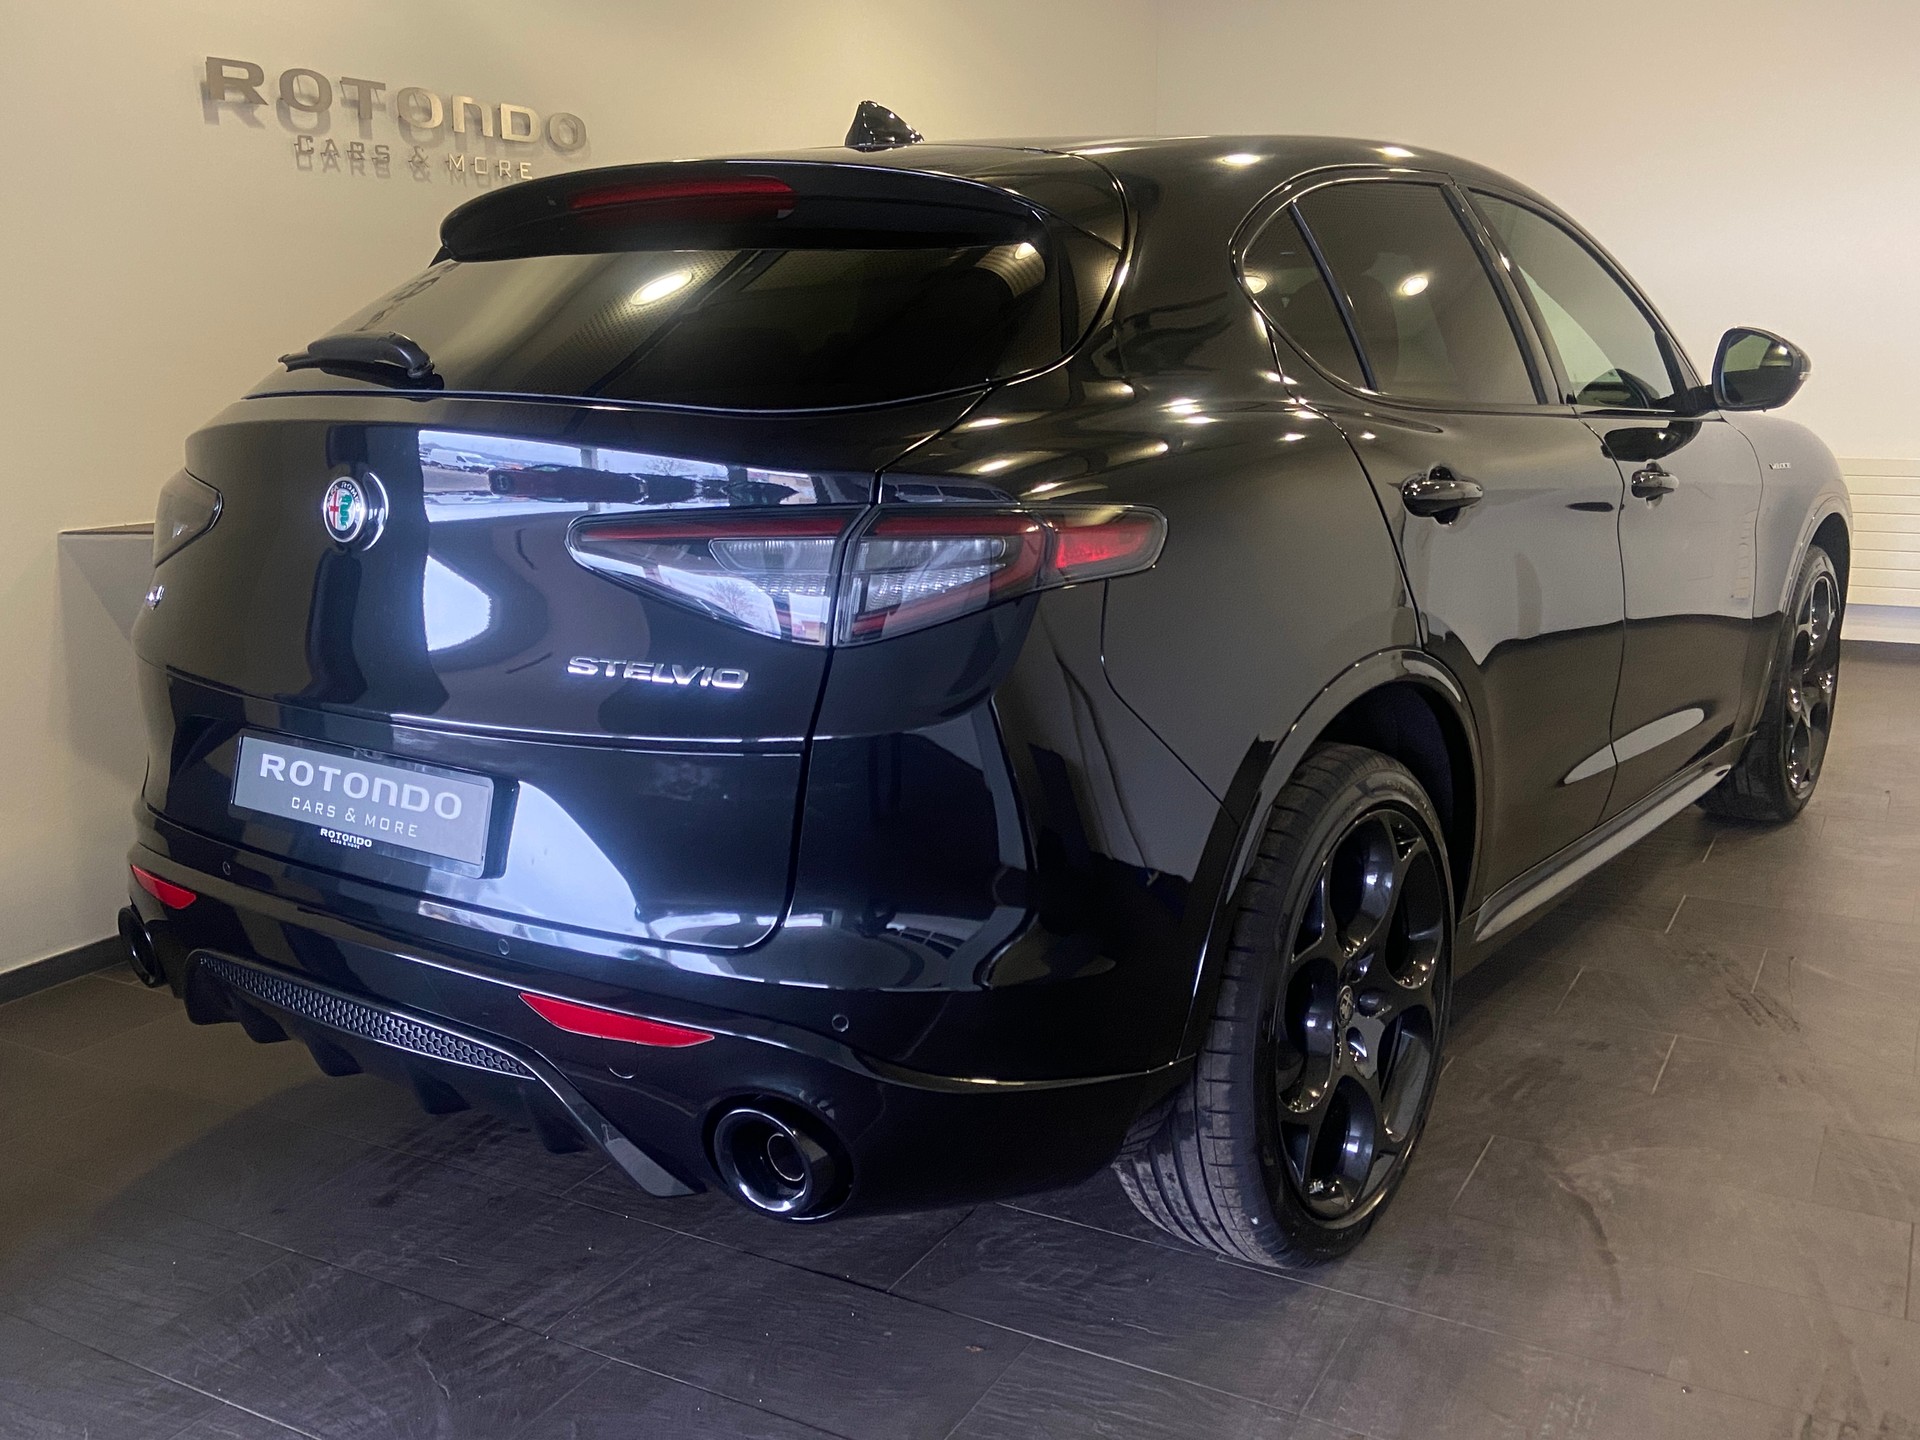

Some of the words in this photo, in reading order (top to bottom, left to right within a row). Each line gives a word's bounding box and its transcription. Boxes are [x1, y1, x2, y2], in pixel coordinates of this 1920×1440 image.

[296, 134, 391, 164] CARS
[411, 145, 429, 169] &
[446, 152, 534, 180] MORE
[567, 655, 749, 689] STELVIO
[291, 797, 336, 818] CARS
[345, 807, 356, 823] &
[364, 812, 418, 838] MORE
